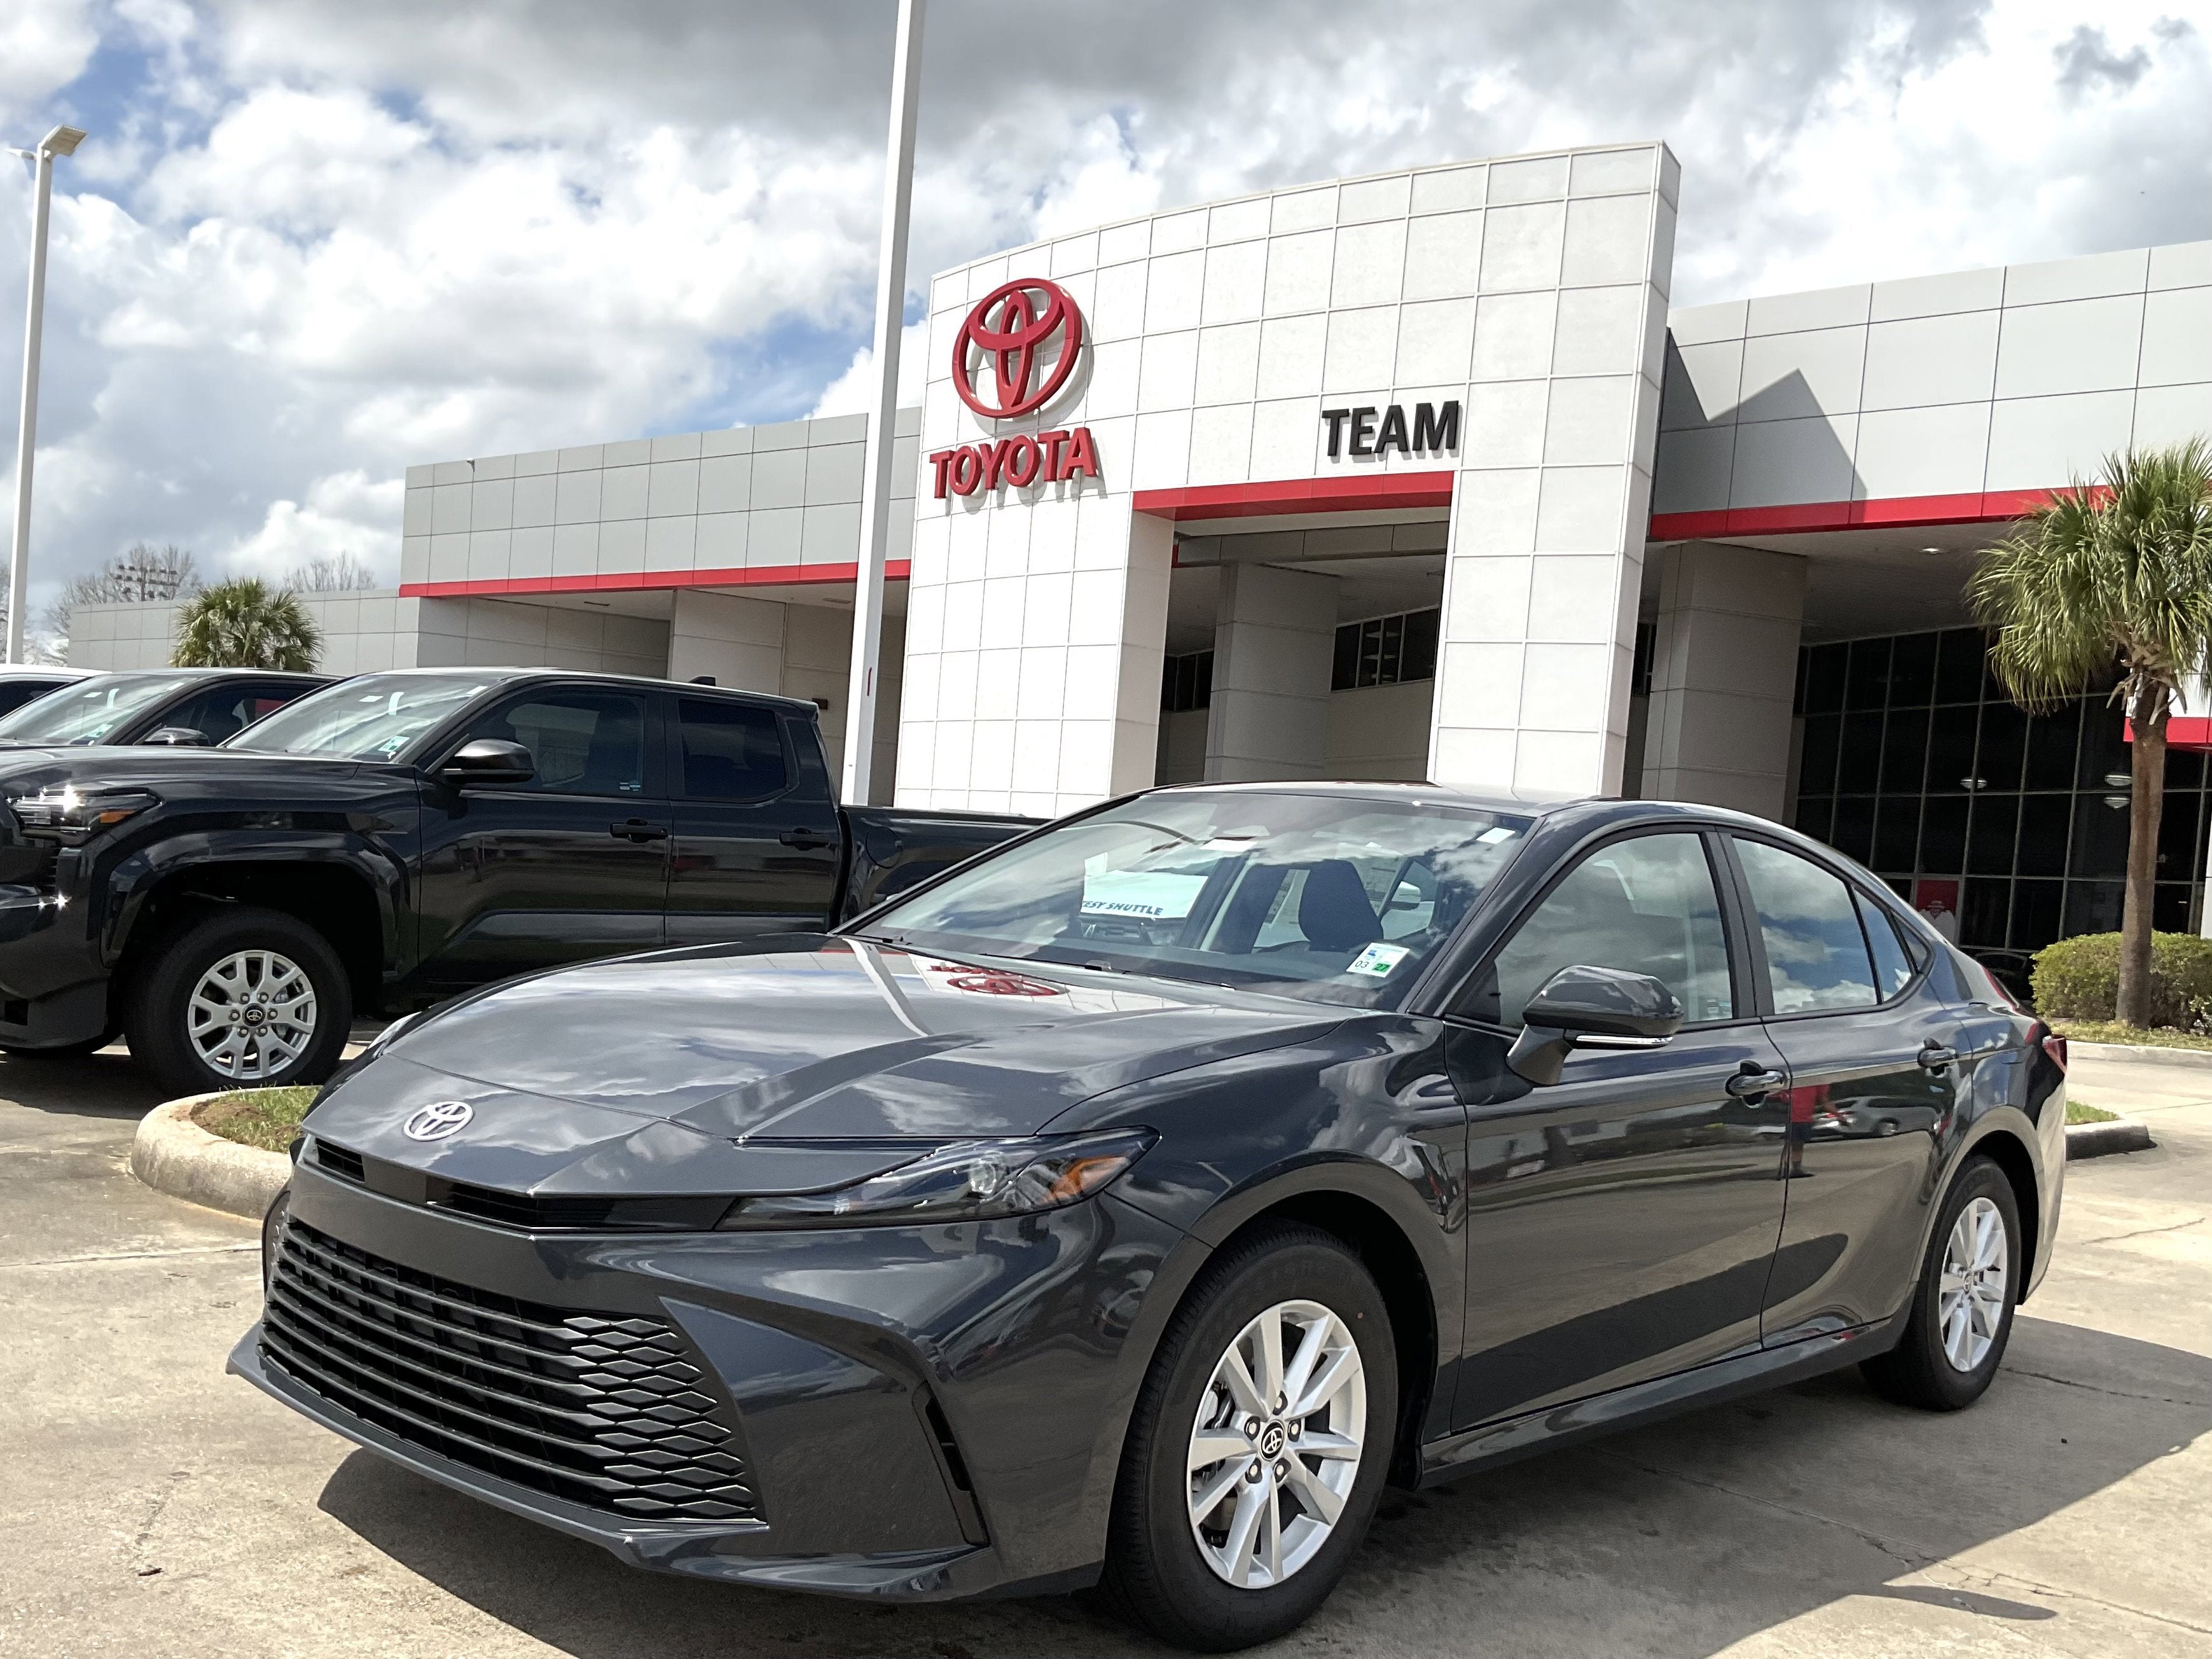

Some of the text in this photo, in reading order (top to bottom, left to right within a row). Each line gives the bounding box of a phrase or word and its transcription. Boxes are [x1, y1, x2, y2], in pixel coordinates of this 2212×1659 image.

[1322, 400, 1459, 456] TEAM
[929, 427, 1098, 499] TOYOTA
[1082, 901, 1163, 916] ESY SHUTTLE
[1355, 960, 1390, 971] 03 27
